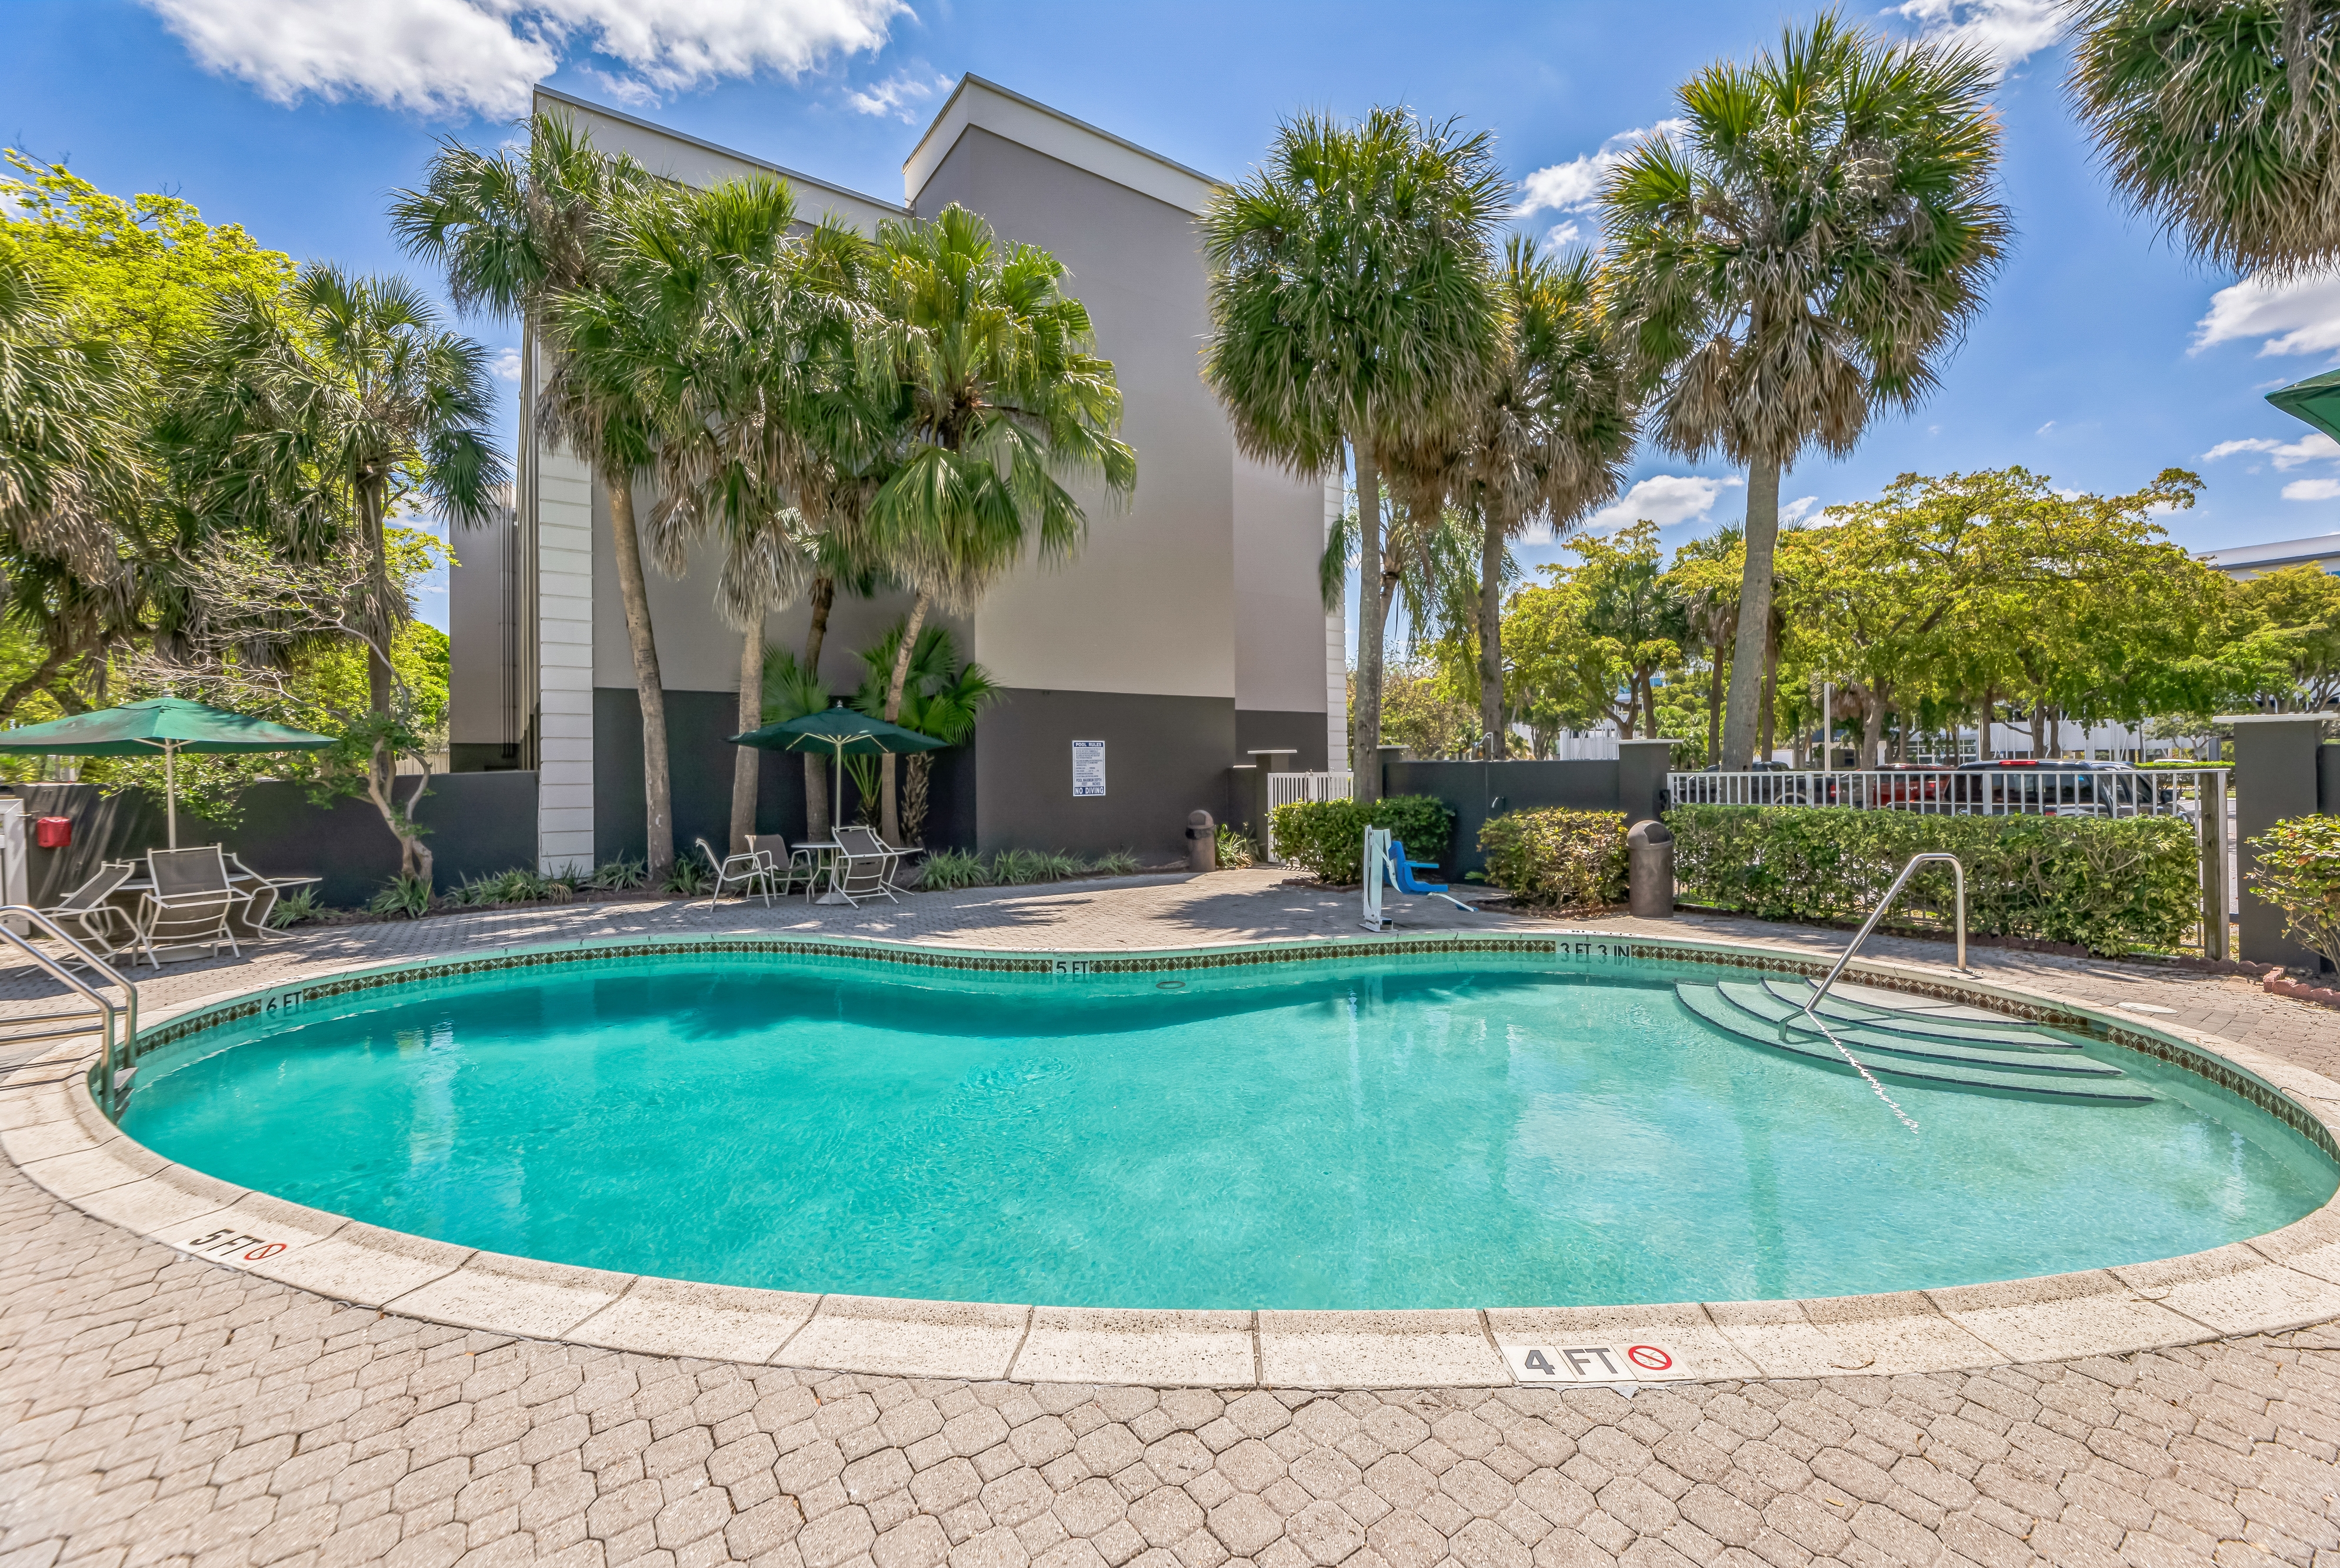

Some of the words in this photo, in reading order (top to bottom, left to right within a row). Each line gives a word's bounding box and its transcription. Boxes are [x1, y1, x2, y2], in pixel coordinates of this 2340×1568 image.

[1560, 942, 1569, 953] 3
[1575, 943, 1591, 954] FT
[1598, 944, 1607, 955] 3
[1614, 945, 1629, 957] IN
[1056, 961, 1067, 973] 5
[1072, 961, 1088, 973] FT
[266, 997, 277, 1011] 6
[284, 991, 302, 1007] FT
[189, 1229, 235, 1246] 5
[206, 1235, 266, 1256] FT
[1525, 1350, 1555, 1375] 4
[1562, 1348, 1618, 1375] FT
